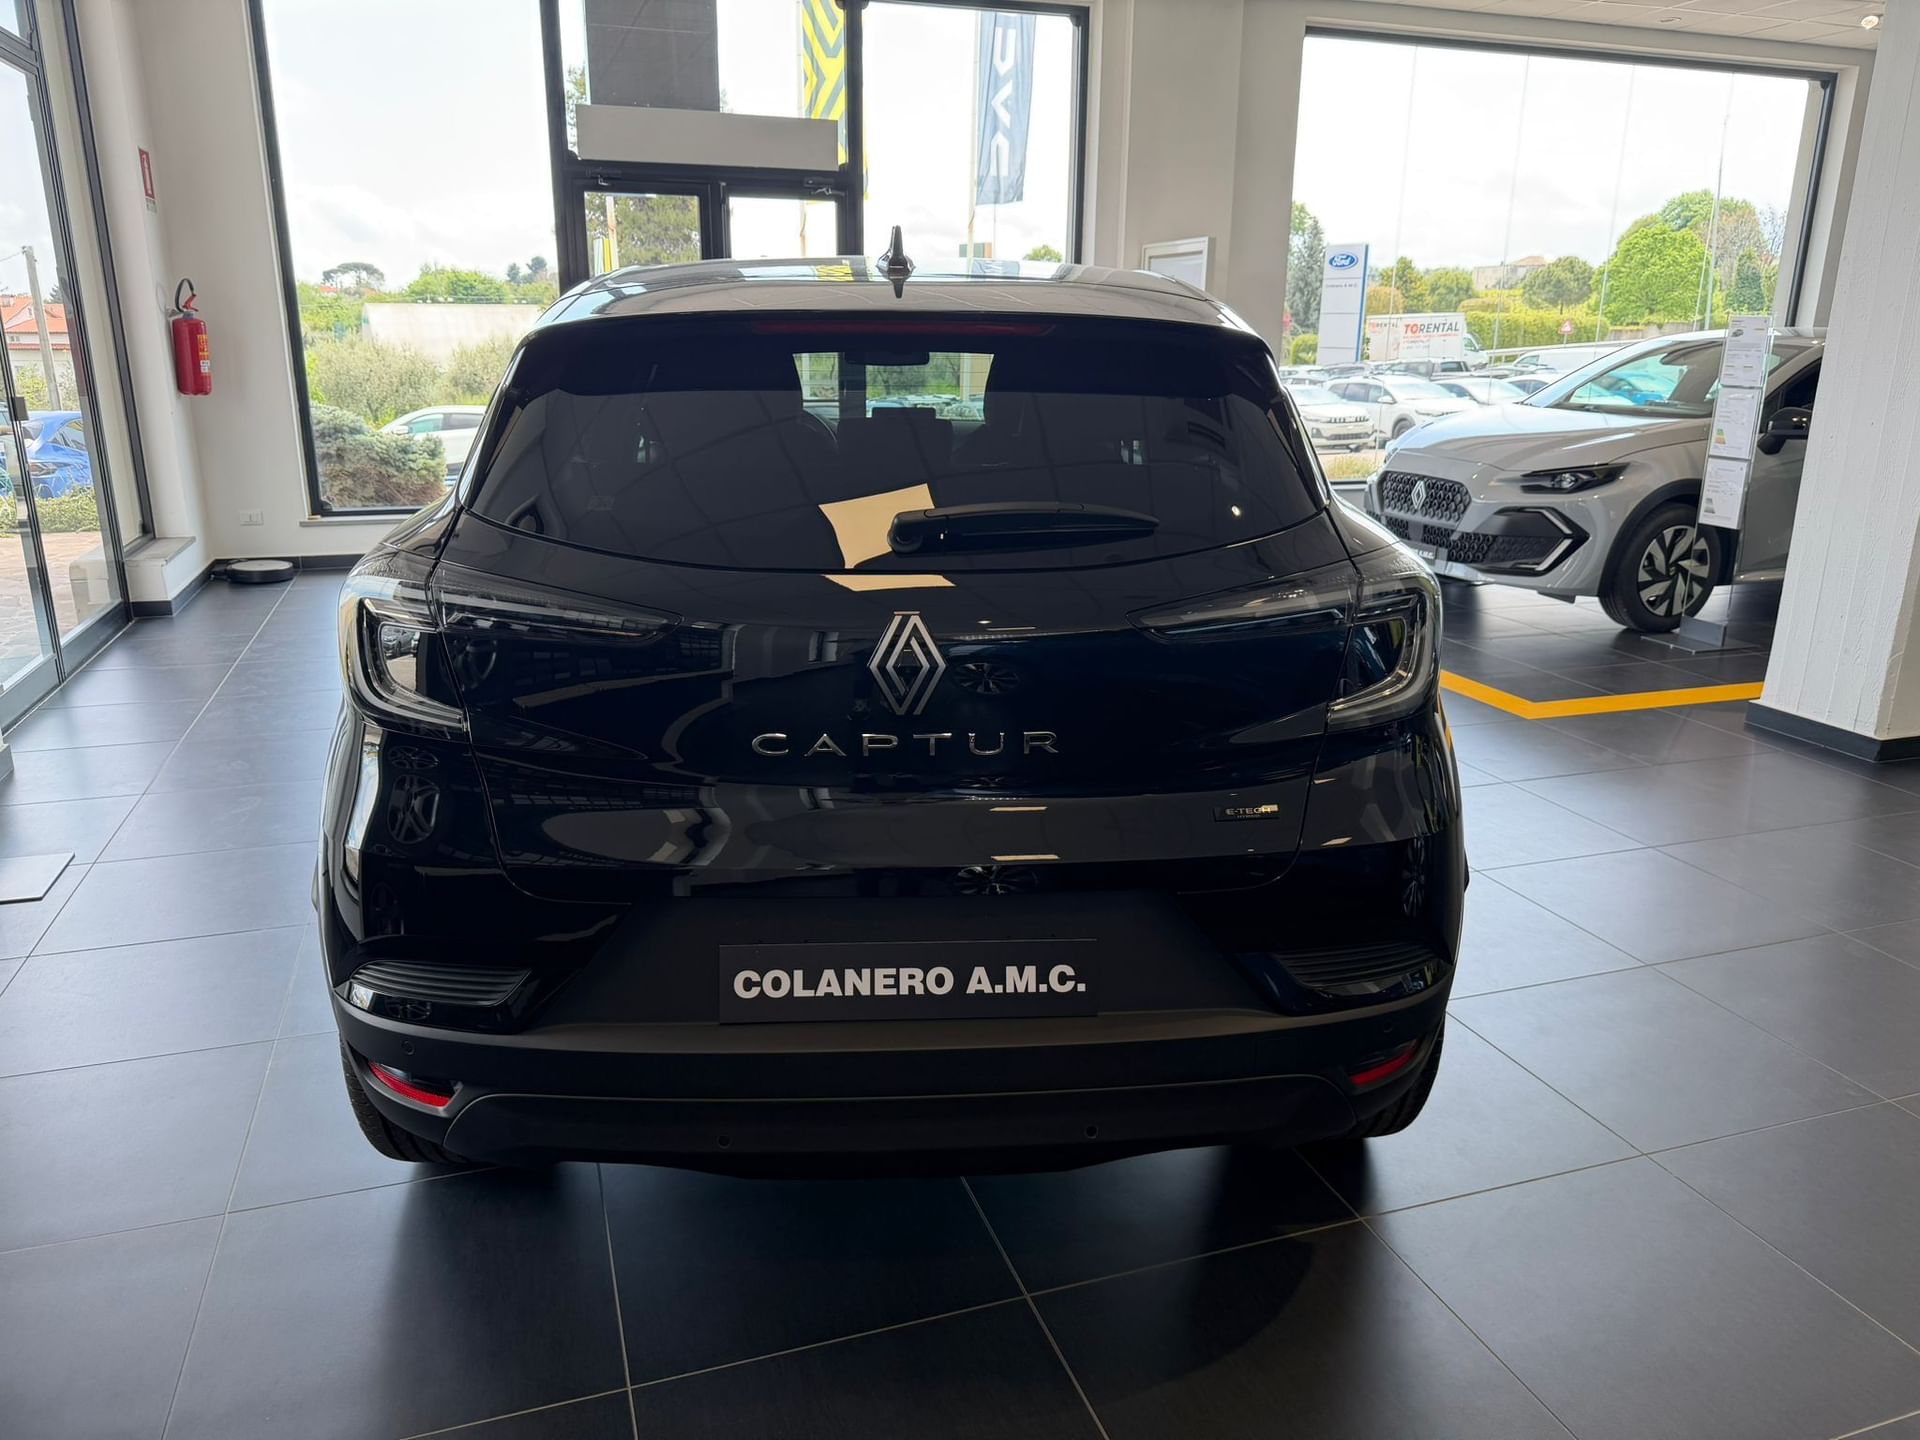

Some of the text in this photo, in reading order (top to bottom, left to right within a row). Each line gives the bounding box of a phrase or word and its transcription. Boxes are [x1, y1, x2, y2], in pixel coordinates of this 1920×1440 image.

[1331, 254, 1353, 267] Ford
[1404, 322, 1460, 334] TORENTAL
[752, 731, 1059, 757] CAPTUR
[1225, 806, 1271, 815] E-TECH
[733, 963, 1087, 999] COLANERO A.M.C.
